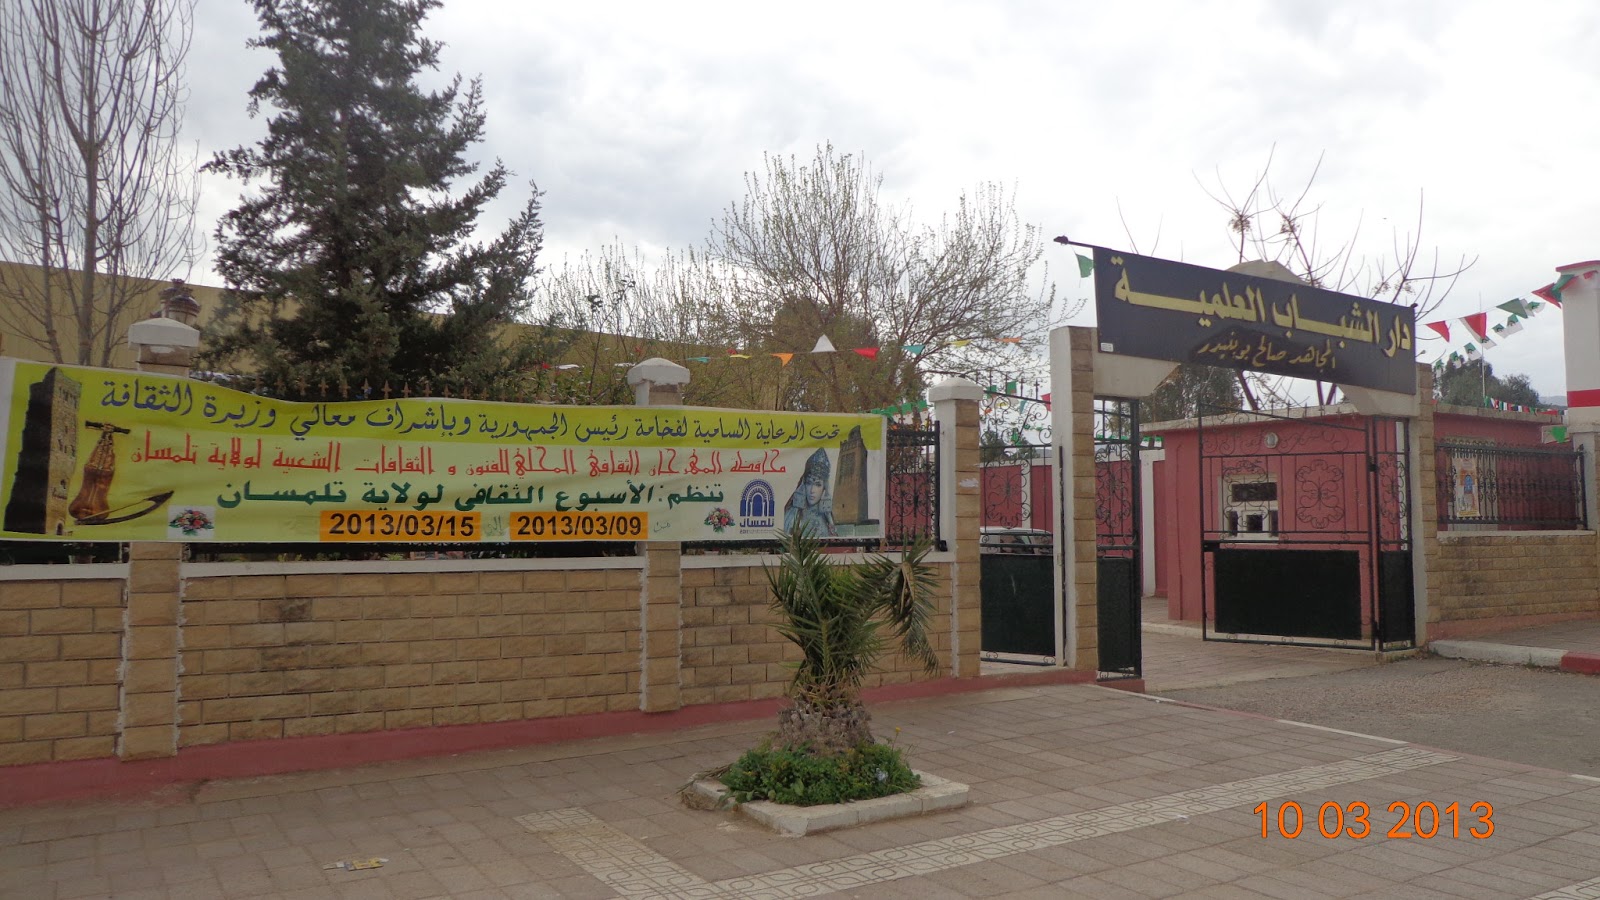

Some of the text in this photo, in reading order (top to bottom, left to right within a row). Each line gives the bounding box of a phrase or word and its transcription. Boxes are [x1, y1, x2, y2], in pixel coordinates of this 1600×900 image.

[1109, 256, 1412, 357] دار الشباب العلمية
[1252, 335, 1287, 368] صالح
[1288, 338, 1337, 373] المجاهد
[101, 378, 194, 417] الثقافة
[203, 394, 277, 429] وزيرة
[289, 403, 356, 441] معالي
[478, 411, 568, 442] الجمهورية
[575, 414, 629, 443] رئيس
[635, 415, 689, 440] لفخامة
[693, 417, 751, 444] السامية
[755, 419, 806, 445] الرعاية
[809, 424, 841, 440] تحت
[130, 429, 199, 465] تلمسان
[207, 436, 263, 471] لولاية
[272, 439, 342, 475] الشعبية
[353, 443, 437, 476] الثقافات
[465, 447, 511, 476] للفنون
[729, 448, 787, 476] محافظة
[447, 465, 457, 476] و
[513, 445, 578, 480] المحلي
[216, 480, 348, 509] تلمسان
[361, 481, 445, 511] لولاية
[555, 479, 655, 512] الأسبوع
[329, 512, 475, 537] 2013/03/15
[516, 515, 642, 536] 2013/03/09
[739, 517, 775, 528] تلمسان
